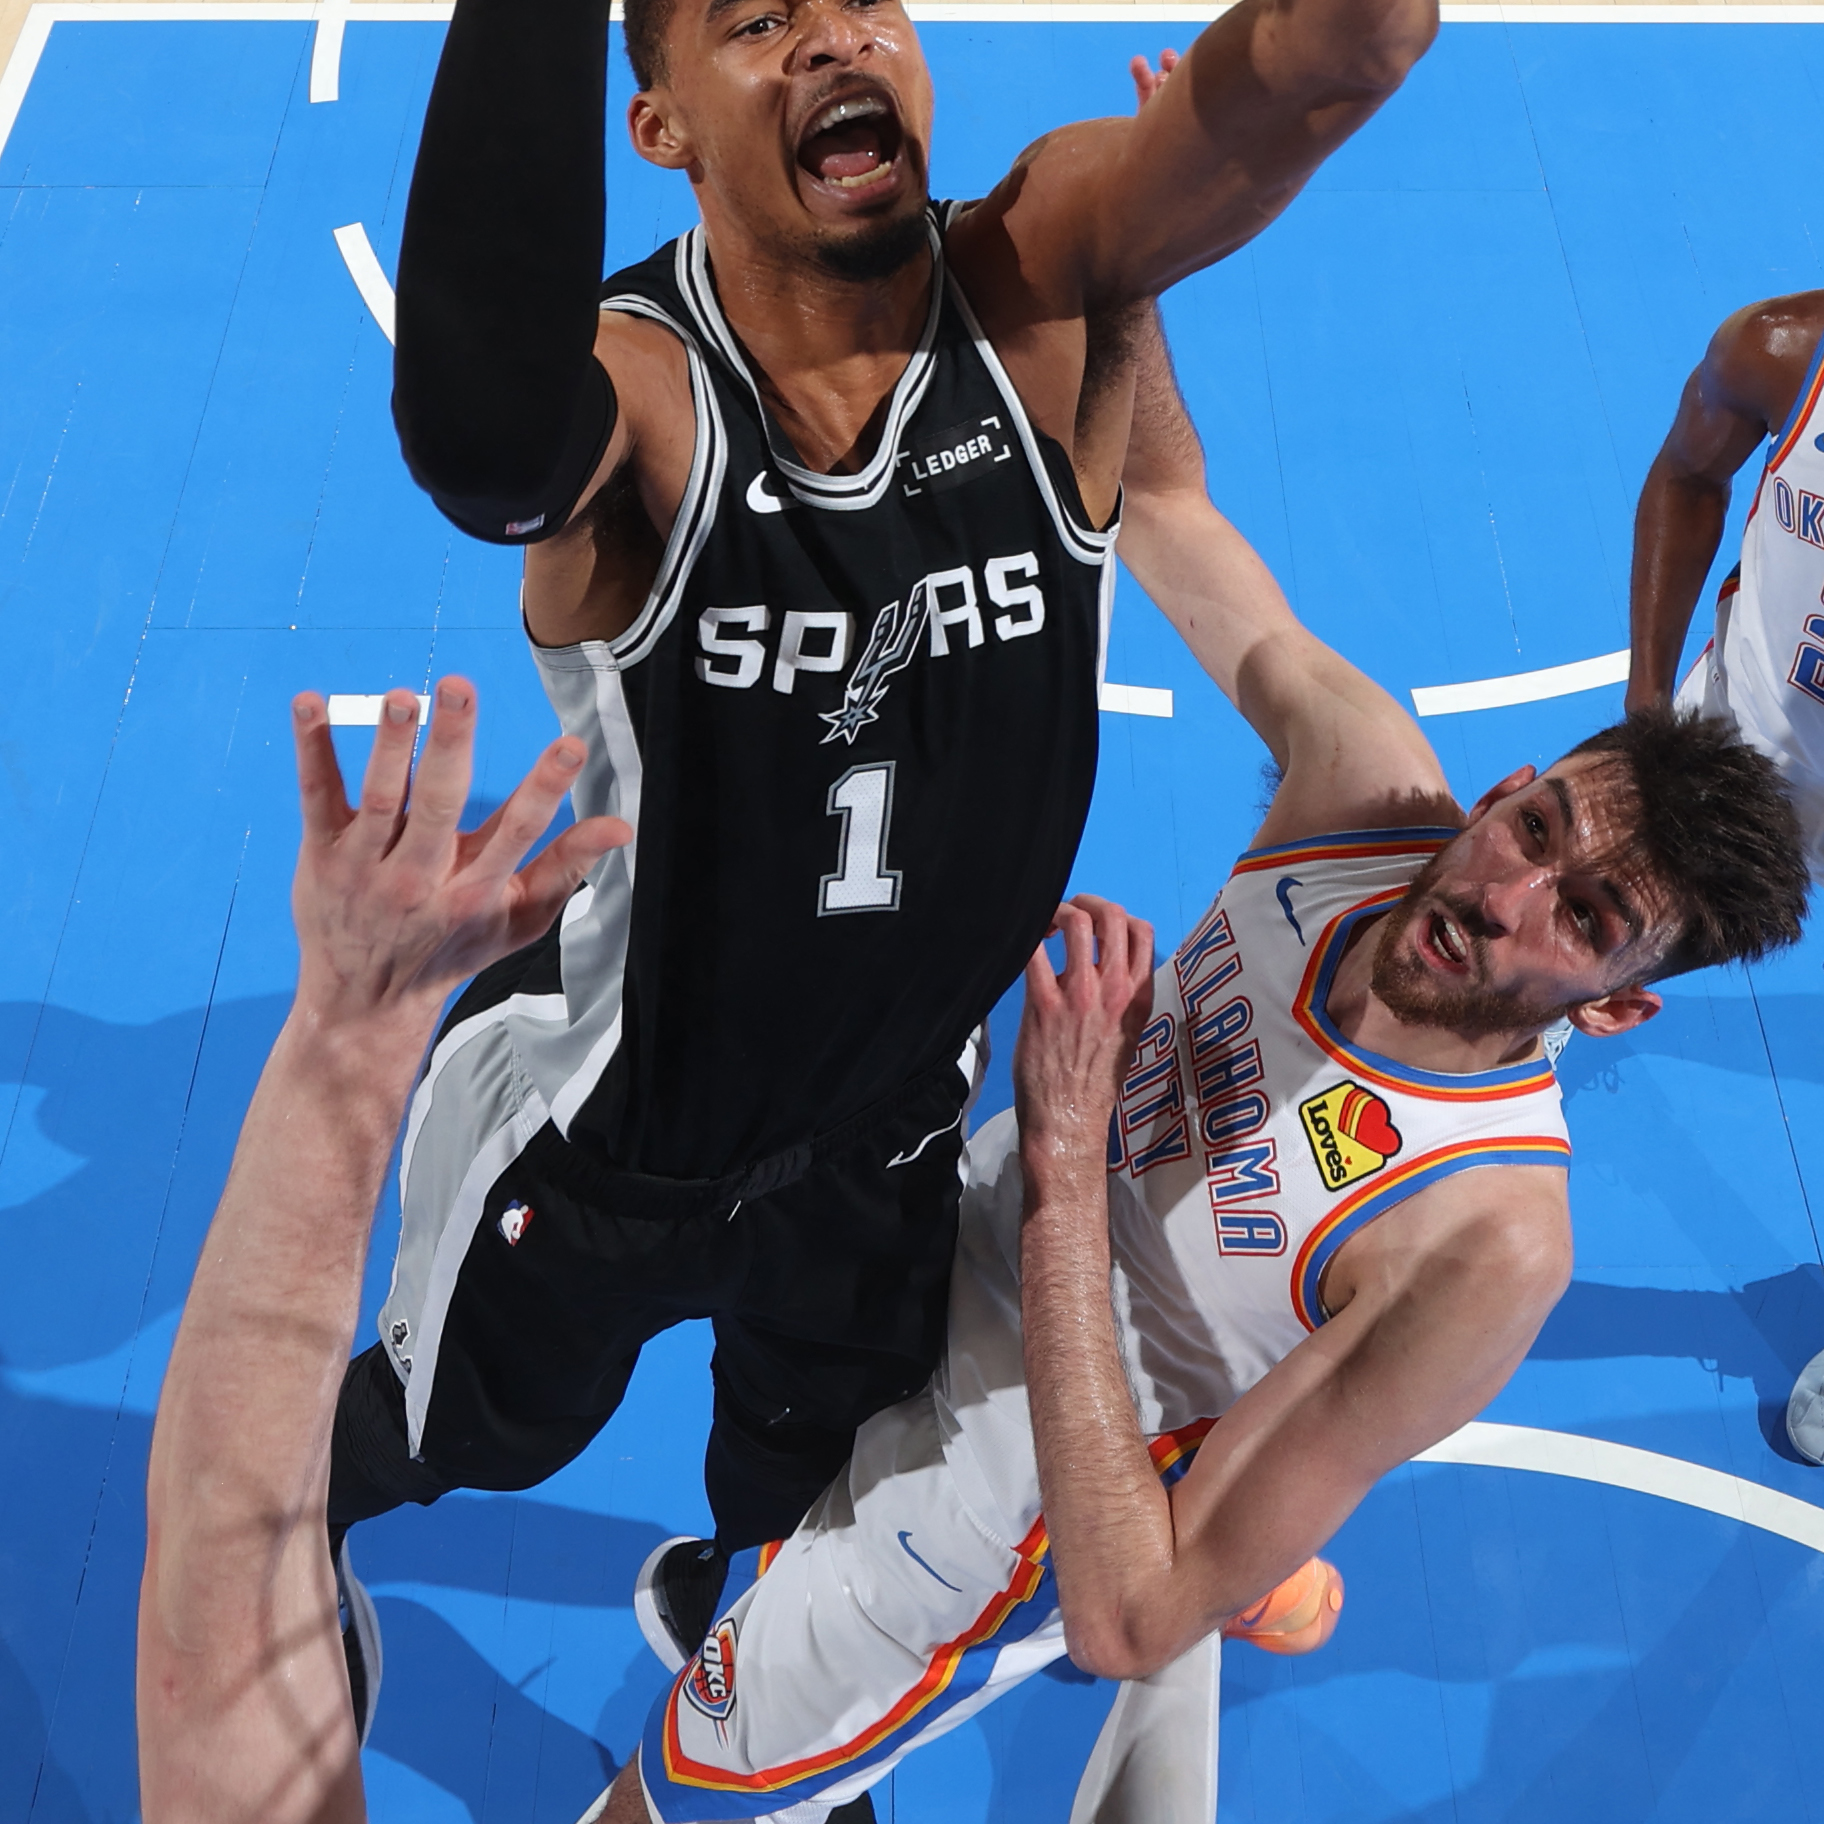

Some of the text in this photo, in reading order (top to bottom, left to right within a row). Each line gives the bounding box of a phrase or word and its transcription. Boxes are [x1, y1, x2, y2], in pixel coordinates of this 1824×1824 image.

[911, 432, 992, 480] LEDGER
[694, 551, 1045, 745] SPURS
[816, 761, 903, 918] 1
[1174, 894, 1289, 1258] KLAHOMA
